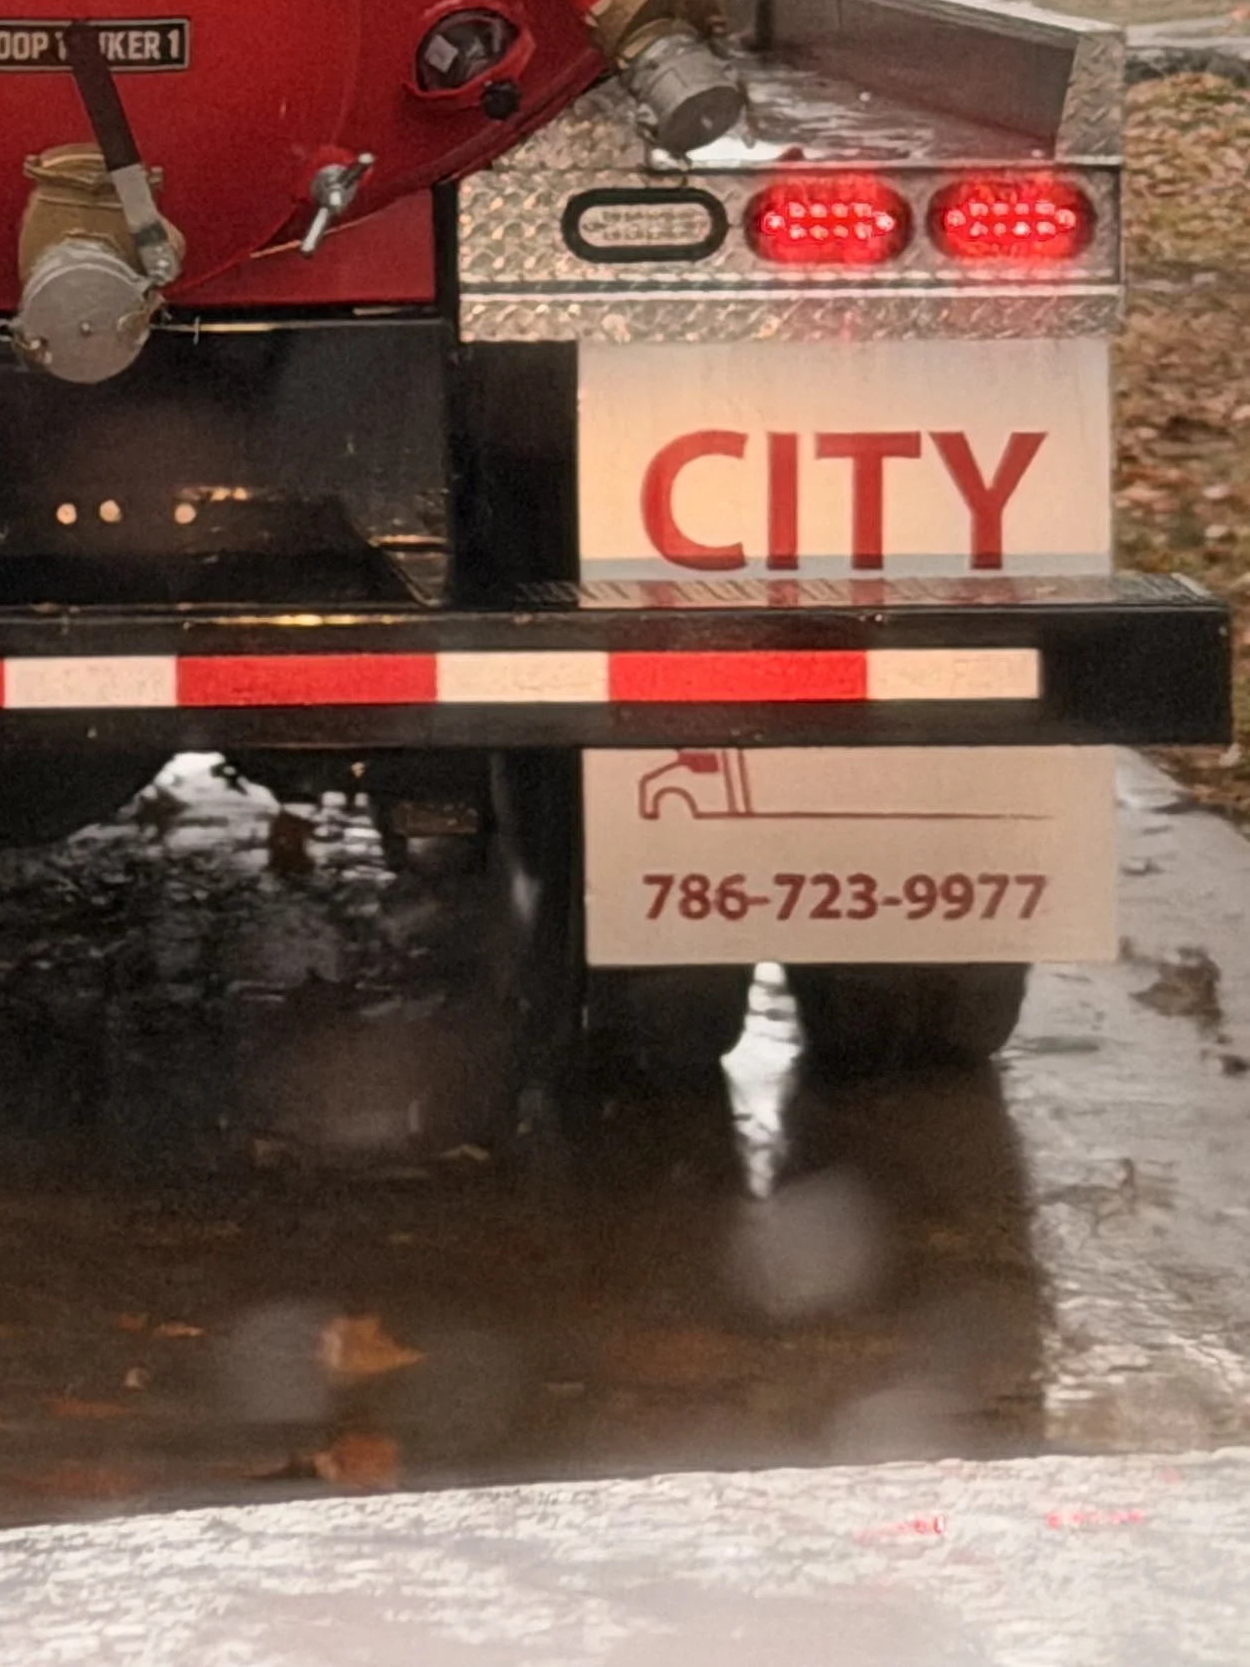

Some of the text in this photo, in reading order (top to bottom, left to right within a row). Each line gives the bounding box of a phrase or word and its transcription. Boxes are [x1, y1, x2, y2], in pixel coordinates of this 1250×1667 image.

[168, 29, 180, 58] 1
[640, 429, 1048, 571] CITY
[642, 873, 1047, 921] 786-723-9977
